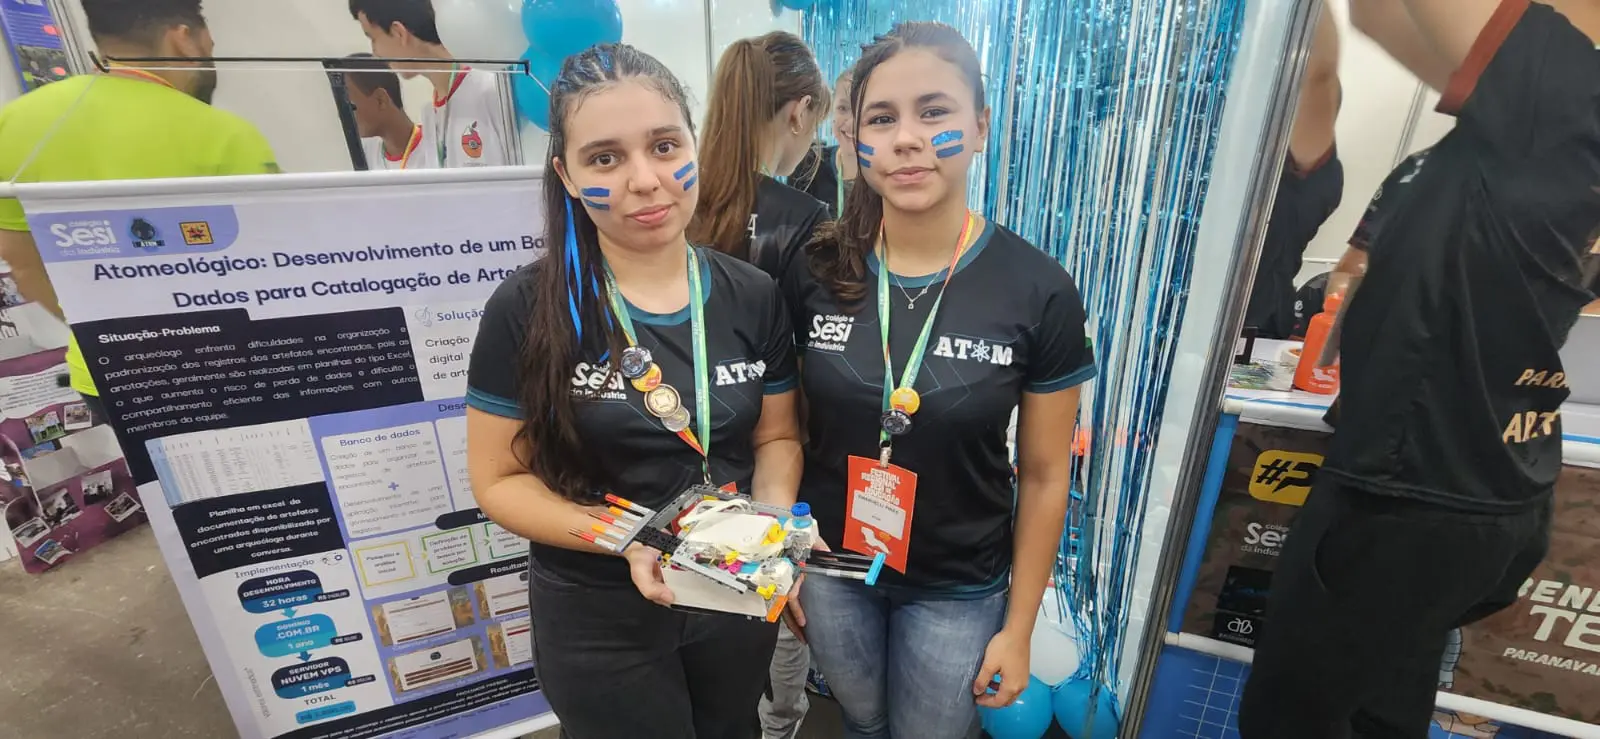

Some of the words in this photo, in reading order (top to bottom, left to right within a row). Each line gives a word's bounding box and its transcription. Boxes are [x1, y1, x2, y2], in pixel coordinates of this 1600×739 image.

[50, 220, 117, 248] Sesi
[94, 255, 267, 281] Atomeológico:
[273, 242, 453, 268] Desenvolvimento
[460, 239, 483, 254] de
[489, 239, 516, 252] um
[521, 235, 544, 249] Ba
[173, 288, 249, 308] Dados
[255, 284, 306, 305] para
[312, 272, 441, 296] Catalogação
[447, 270, 471, 285] de
[437, 308, 485, 321] Solução
[98, 324, 220, 344] Situação-Problema
[809, 314, 854, 342] Sesi
[99, 356, 109, 365] O
[124, 349, 182, 361] arqueólogo
[195, 343, 236, 354] enfrenta
[248, 336, 303, 349] dificuldades
[337, 327, 390, 340] organização
[425, 336, 470, 347] Criação
[104, 363, 177, 381] padronização
[182, 361, 200, 369] dos
[204, 356, 246, 368] registros
[250, 354, 268, 362] dos
[272, 349, 313, 360] artefatos
[378, 340, 396, 349] pois
[429, 352, 464, 364] digital
[172, 373, 226, 386] geralmente
[229, 369, 246, 378] são
[249, 365, 295, 376] realizadas
[298, 362, 313, 370] em
[314, 358, 352, 369] planilhas
[369, 353, 385, 363] tipo
[433, 372, 446, 380] de
[1514, 368, 1569, 388] PAR
[121, 400, 212, 420] compartilhamento
[223, 395, 263, 406] eficiente
[273, 391, 290, 400] das
[300, 384, 354, 396] informações
[363, 380, 383, 389] com
[391, 375, 418, 385] outros
[132, 395, 154, 404] que
[224, 383, 247, 392] risco
[254, 381, 266, 389] de
[273, 377, 300, 388] perda
[307, 375, 318, 383] de
[325, 371, 352, 381] dados
[126, 418, 178, 434] membros
[180, 415, 193, 424] da
[340, 436, 372, 447] Banco
[375, 434, 387, 442] de
[390, 429, 421, 439] dados
[208, 505, 245, 518] Planilha
[247, 504, 261, 512] em
[262, 501, 286, 509] excel
[197, 515, 265, 534] documentação
[267, 513, 278, 522] de
[279, 508, 319, 519] artefatos
[191, 530, 250, 548] encontrados
[316, 517, 332, 526] por
[214, 545, 234, 554] uma
[286, 530, 319, 541] durante
[235, 558, 315, 579] Implementação
[490, 561, 529, 574] Resultad
[243, 579, 316, 597] DESENVOLVIMENTO
[265, 576, 291, 586] HORA
[262, 599, 276, 608] 32
[278, 594, 308, 605] horas
[289, 661, 329, 675] SERVIDOR
[1503, 647, 1600, 676] PARANAVA
[280, 670, 320, 686] NUVEM
[320, 665, 342, 677] VPS
[304, 693, 336, 705] TOTAL
